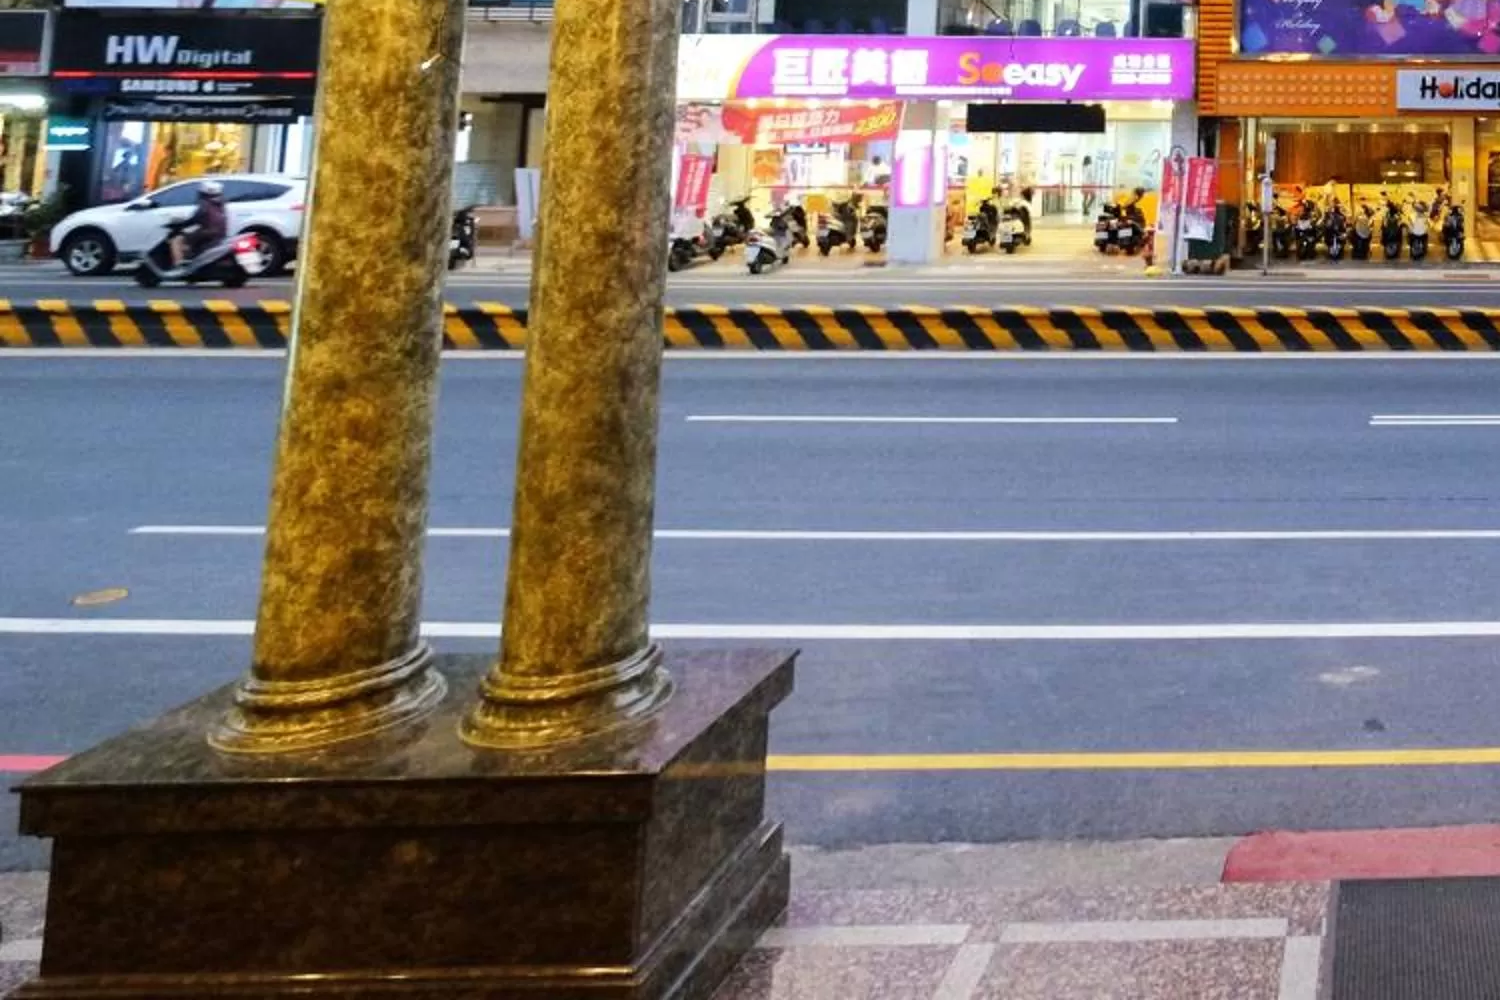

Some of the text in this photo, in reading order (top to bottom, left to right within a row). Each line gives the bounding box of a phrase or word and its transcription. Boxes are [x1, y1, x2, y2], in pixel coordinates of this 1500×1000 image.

[106, 34, 252, 66] HW Digital
[120, 79, 199, 93] SAMSUNG
